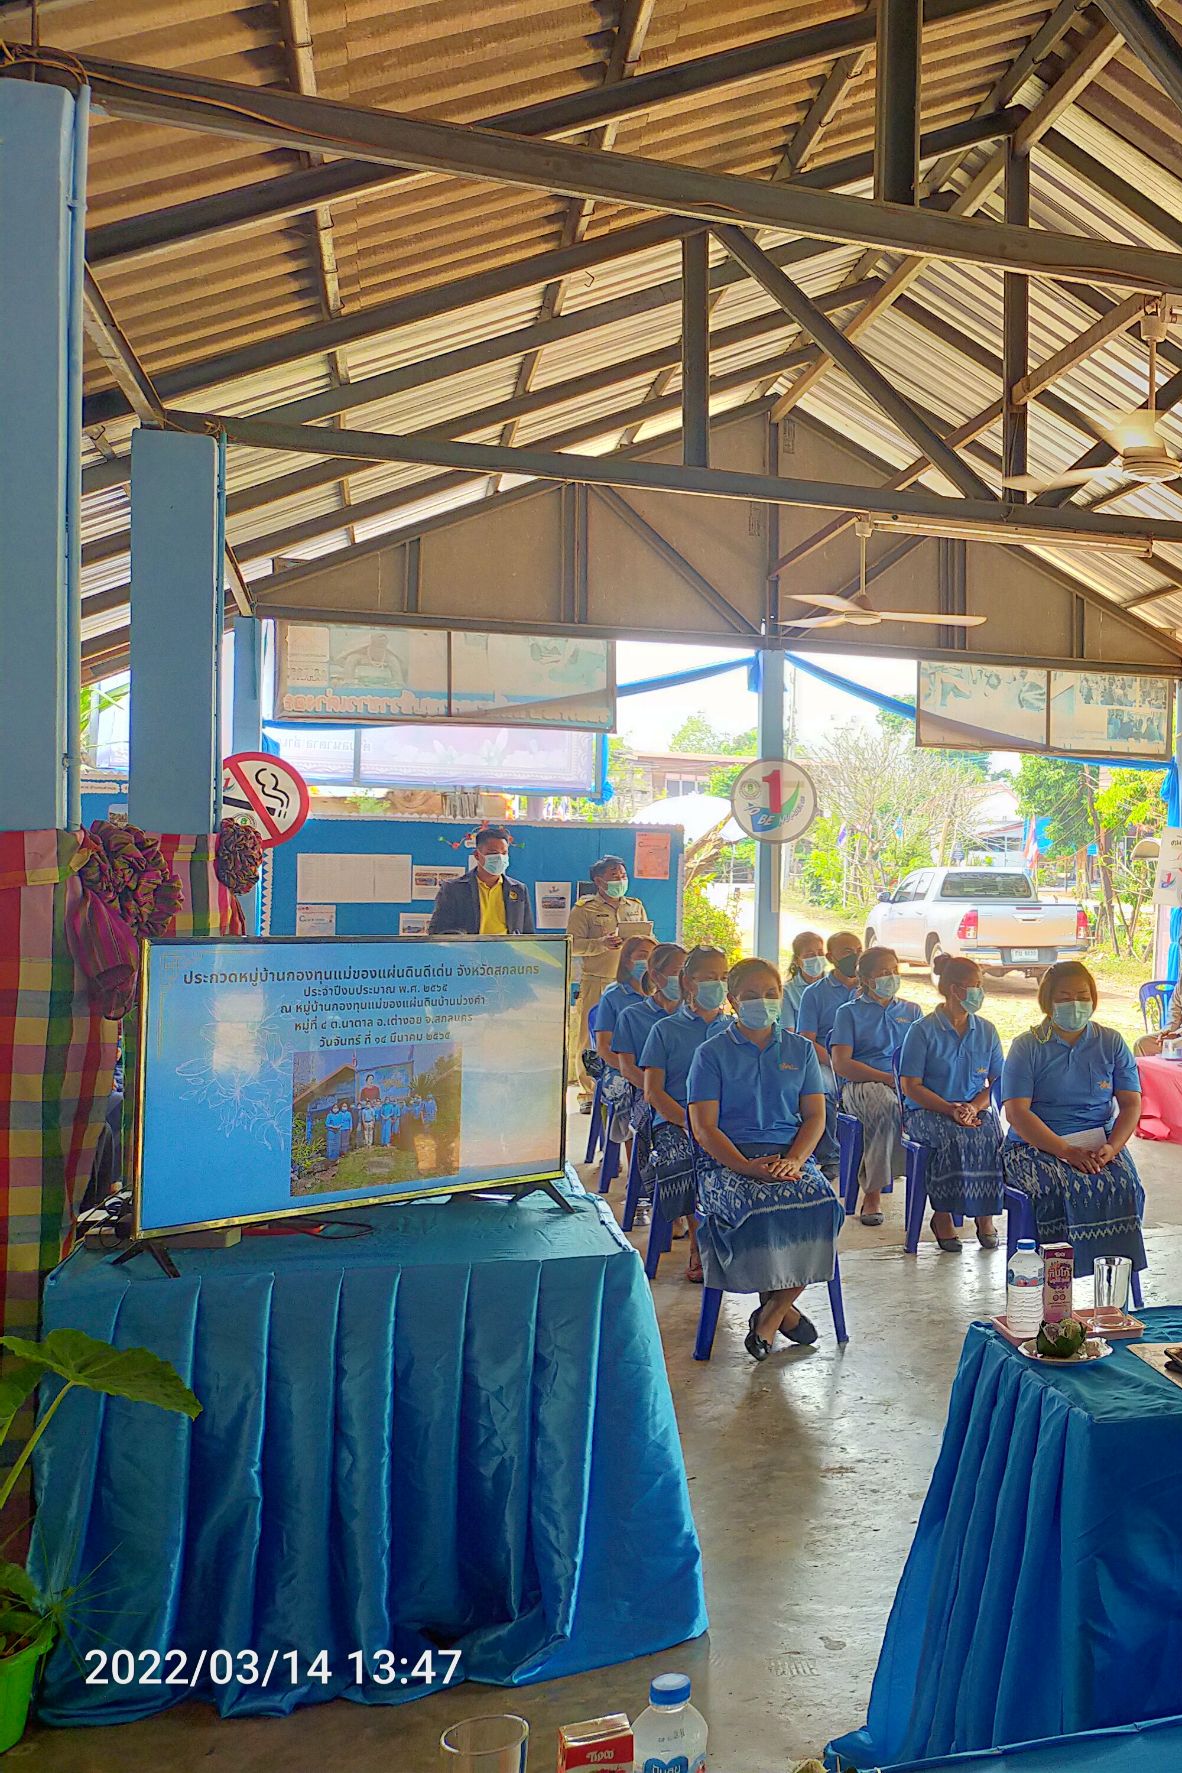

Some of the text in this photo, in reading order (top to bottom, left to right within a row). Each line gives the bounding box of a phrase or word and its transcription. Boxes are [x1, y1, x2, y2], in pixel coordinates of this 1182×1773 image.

[183, 964, 540, 986] ประกวดหมู่บ้านกองทุนแม่ของแผ่นดินดีเด่น จังหวัดสกลนคร
[303, 984, 396, 997] ประจำปีงบประมาณ
[280, 995, 485, 1015] ณ หมู่บ้านกองทุนแม่ของแผ่นดินบ้านม่วงคำ
[319, 1034, 360, 1048] วันจันทร์
[390, 1032, 422, 1043] มีนาคม
